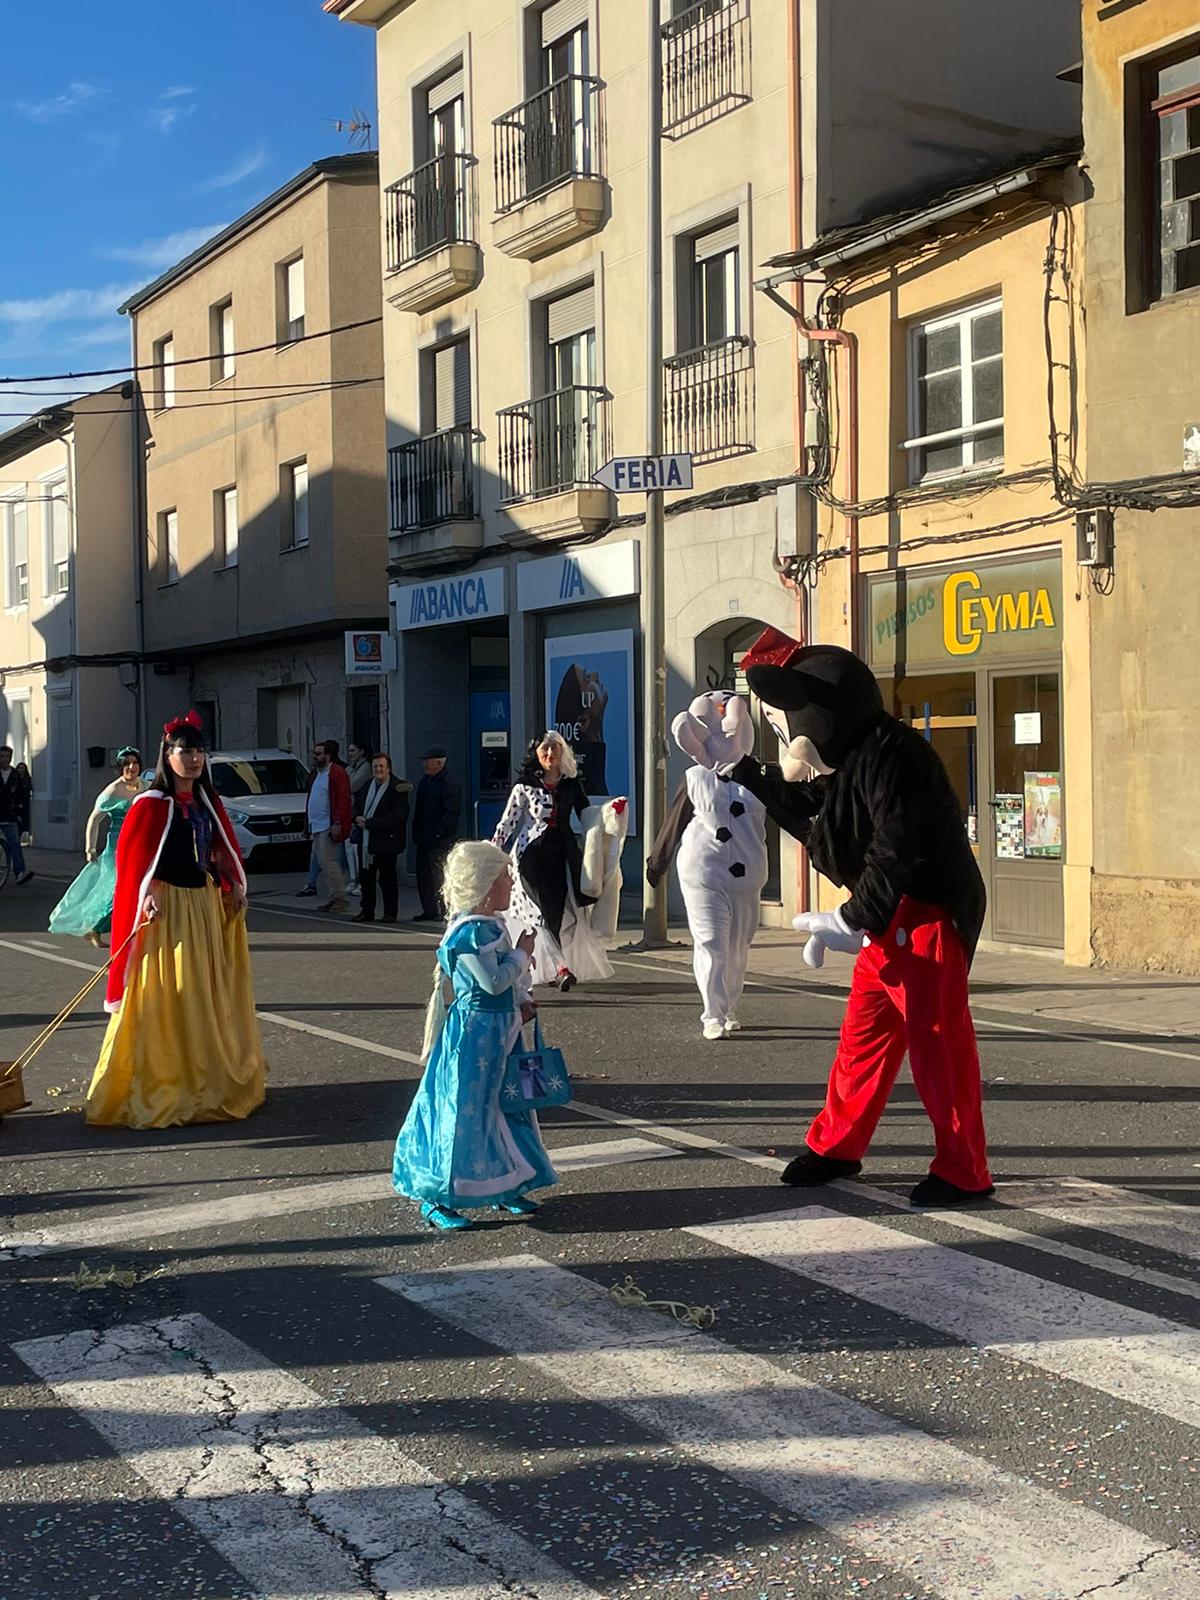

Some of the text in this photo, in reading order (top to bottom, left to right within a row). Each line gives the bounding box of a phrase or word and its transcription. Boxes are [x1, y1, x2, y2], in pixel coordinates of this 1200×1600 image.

[614, 458, 682, 490] FERIA
[943, 571, 1056, 656] CEYMA
[581, 691, 596, 708] UP
